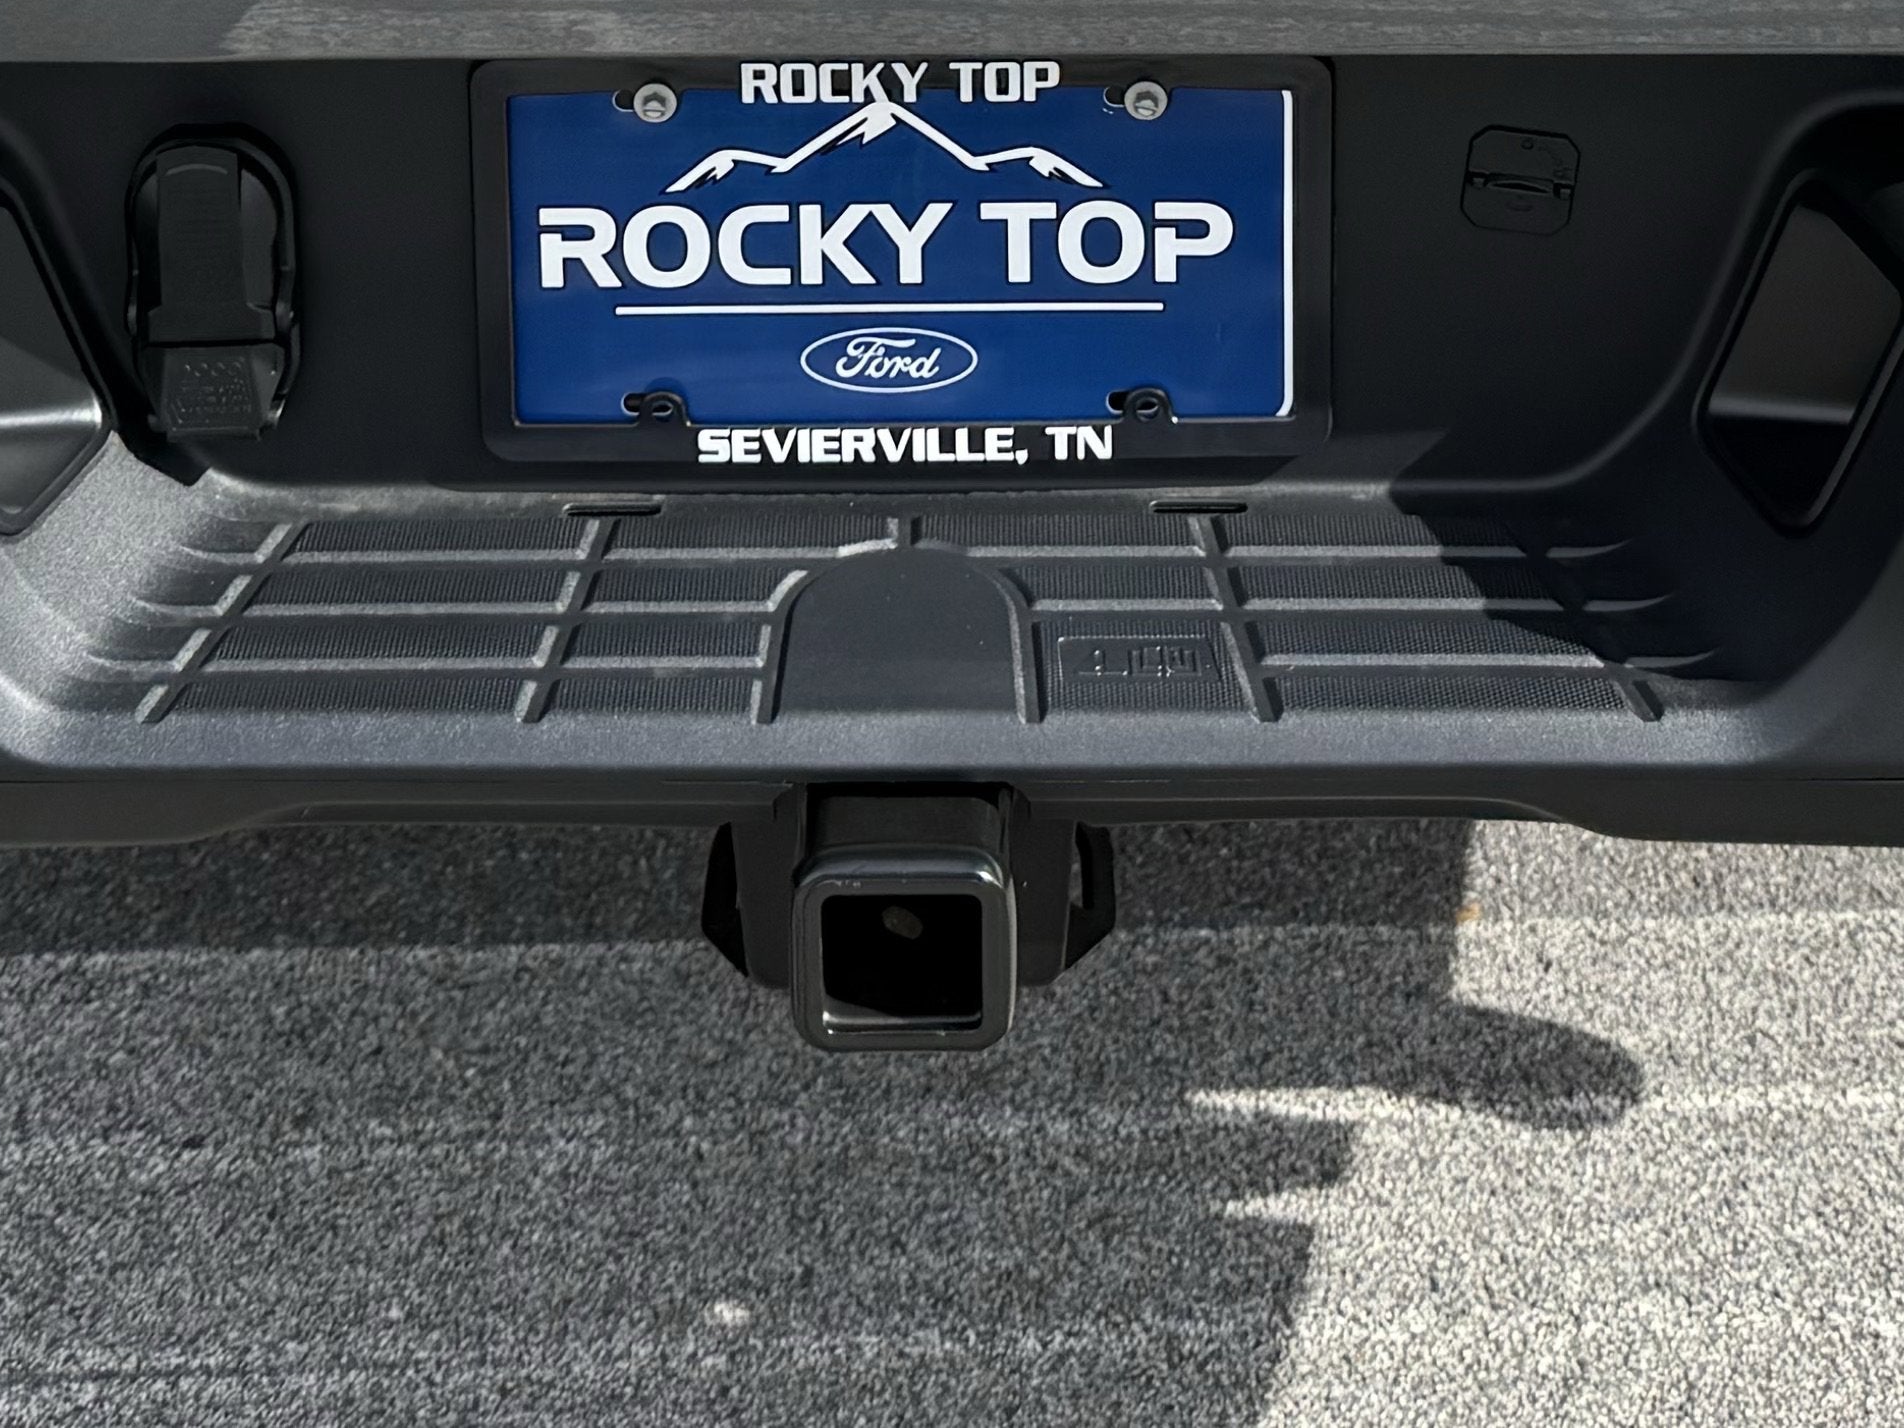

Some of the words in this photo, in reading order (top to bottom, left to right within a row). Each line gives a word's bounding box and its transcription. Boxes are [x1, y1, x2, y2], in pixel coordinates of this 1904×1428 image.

[740, 61, 929, 104] ROCKY
[948, 60, 1061, 103] TOP
[537, 202, 954, 289] ROCKY
[979, 199, 1235, 285] TOP
[834, 336, 943, 382] Ford
[697, 426, 1027, 465] SEVIERVILLE,
[1045, 425, 1113, 460] TN
